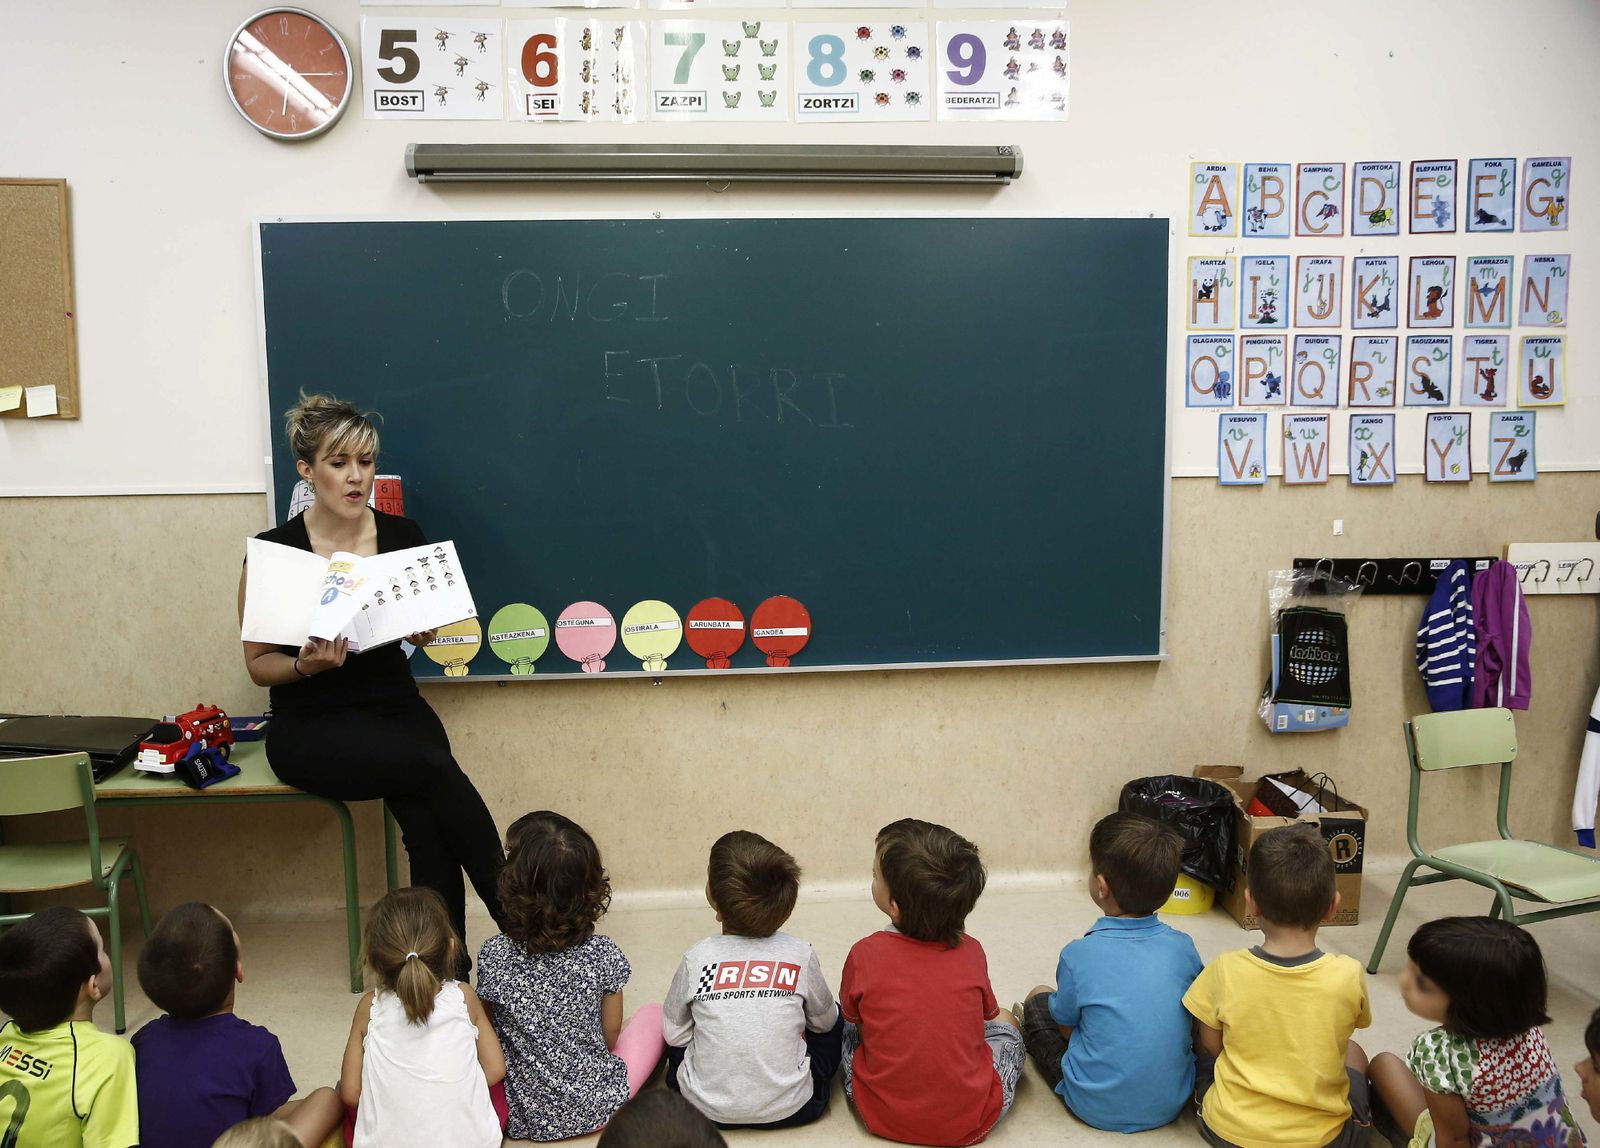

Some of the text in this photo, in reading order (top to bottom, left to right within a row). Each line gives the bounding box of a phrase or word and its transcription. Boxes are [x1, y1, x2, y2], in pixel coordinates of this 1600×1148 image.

[376, 29, 421, 84] 5
[520, 33, 559, 88] 6
[663, 32, 706, 85] 7
[806, 34, 848, 87] 8
[946, 33, 987, 86] 9
[379, 94, 419, 107] BOST
[533, 99, 555, 110] SEI
[659, 96, 702, 107] ZAZPI
[803, 98, 855, 109] ZORTZI
[945, 96, 995, 105] BEDERATZI
[1195, 173, 1209, 184] a
[1248, 174, 1261, 192] b
[1322, 175, 1341, 192] c
[1384, 171, 1398, 190] d
[1436, 174, 1452, 187] e
[1551, 168, 1566, 188] g
[1196, 174, 1232, 217] A
[1260, 175, 1285, 218] B
[1360, 177, 1386, 215] D
[1414, 176, 1436, 218] E
[1474, 175, 1497, 217] F
[1525, 178, 1554, 218] G
[1302, 190, 1330, 233] C
[1220, 268, 1234, 288] h
[1269, 266, 1280, 286] i
[1302, 267, 1314, 293] j
[1382, 268, 1394, 286] k
[1442, 266, 1451, 287] l
[1480, 266, 1499, 280] m
[1550, 265, 1566, 278] n
[501, 268, 671, 322] ONGI
[1192, 278, 1220, 324] H
[1248, 276, 1260, 319] I
[1307, 272, 1335, 320] J
[1357, 274, 1381, 319] K
[1414, 274, 1437, 320] L
[1468, 276, 1506, 324] M
[1524, 276, 1550, 313] N
[1322, 348, 1338, 370] q
[1491, 346, 1504, 366] t
[1534, 345, 1552, 358] u
[1190, 355, 1220, 395] O
[1244, 356, 1268, 398] P
[1298, 360, 1326, 399] Q
[1350, 361, 1374, 401] R
[1410, 356, 1431, 395] S
[1466, 356, 1490, 394] T
[1528, 358, 1554, 400] U
[602, 349, 856, 429] ETORRI
[1228, 428, 1249, 441] v
[1300, 428, 1320, 440] w
[1354, 427, 1374, 441] x
[1452, 424, 1467, 446] y
[1514, 424, 1530, 438] z
[1224, 438, 1254, 479] V
[1292, 442, 1326, 478] W
[1367, 442, 1390, 480] X
[1431, 438, 1456, 478] Y
[1494, 438, 1518, 476] Z
[304, 486, 309, 496] 2
[381, 483, 388, 494] 6
[380, 502, 392, 512] 13
[558, 618, 594, 626] OSTEGUNA
[626, 624, 659, 633] OSTIRALA
[429, 636, 464, 644] STEARTEA
[491, 630, 536, 641] ASTEAZKENA
[1335, 838, 1351, 860] R
[718, 966, 797, 986] RSN
[722, 990, 756, 1000] SPORTS
